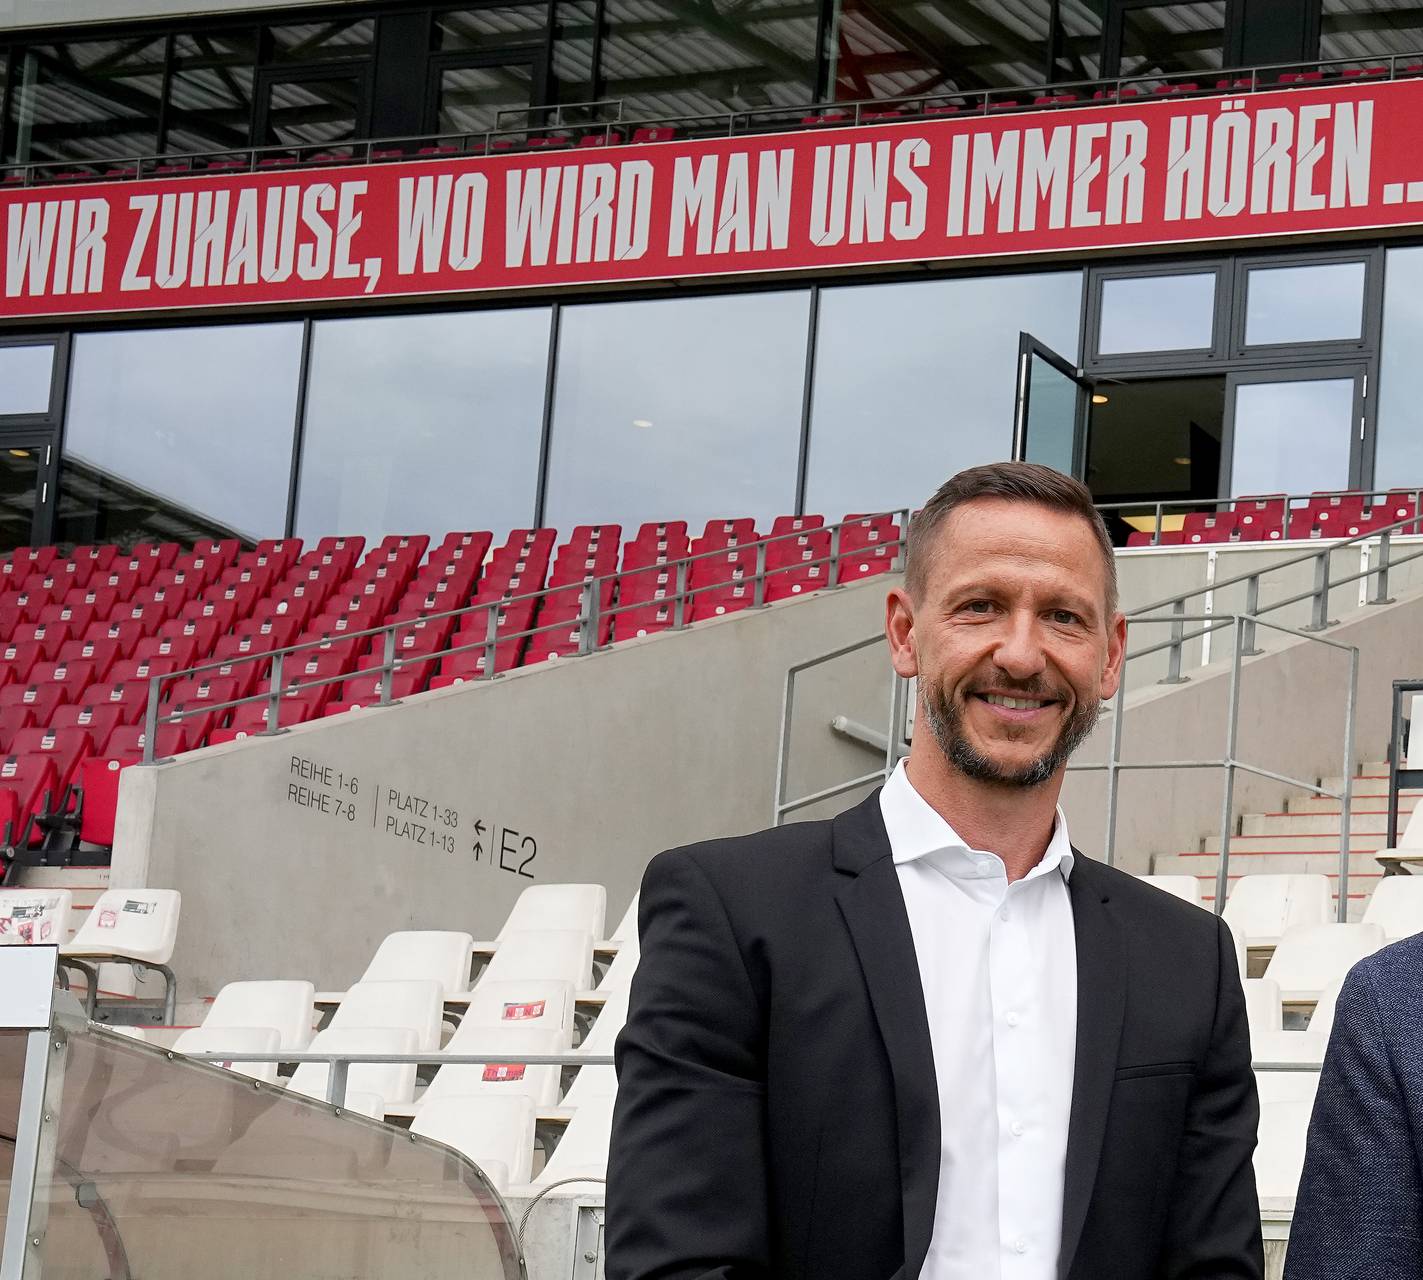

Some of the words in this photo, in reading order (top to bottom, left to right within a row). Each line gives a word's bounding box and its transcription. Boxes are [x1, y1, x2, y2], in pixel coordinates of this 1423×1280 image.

[5, 198, 110, 297] WIR
[120, 180, 382, 294] ZUHAUSE,
[398, 172, 488, 275] WO
[505, 160, 654, 268] WIRD
[667, 148, 795, 257] MAN
[809, 138, 931, 247] UNS
[946, 119, 1149, 237] IMMER
[1164, 99, 1374, 221] HÖREN
[290, 755, 334, 787] REIHE
[338, 772, 359, 795] 1-6
[287, 783, 331, 814] REIHE
[335, 798, 356, 822] 7-8
[388, 789, 429, 819] PLATZ
[432, 805, 458, 828] 1-33
[385, 815, 427, 845] PLATZ
[429, 831, 455, 854] 1-13
[499, 827, 537, 880] E2
